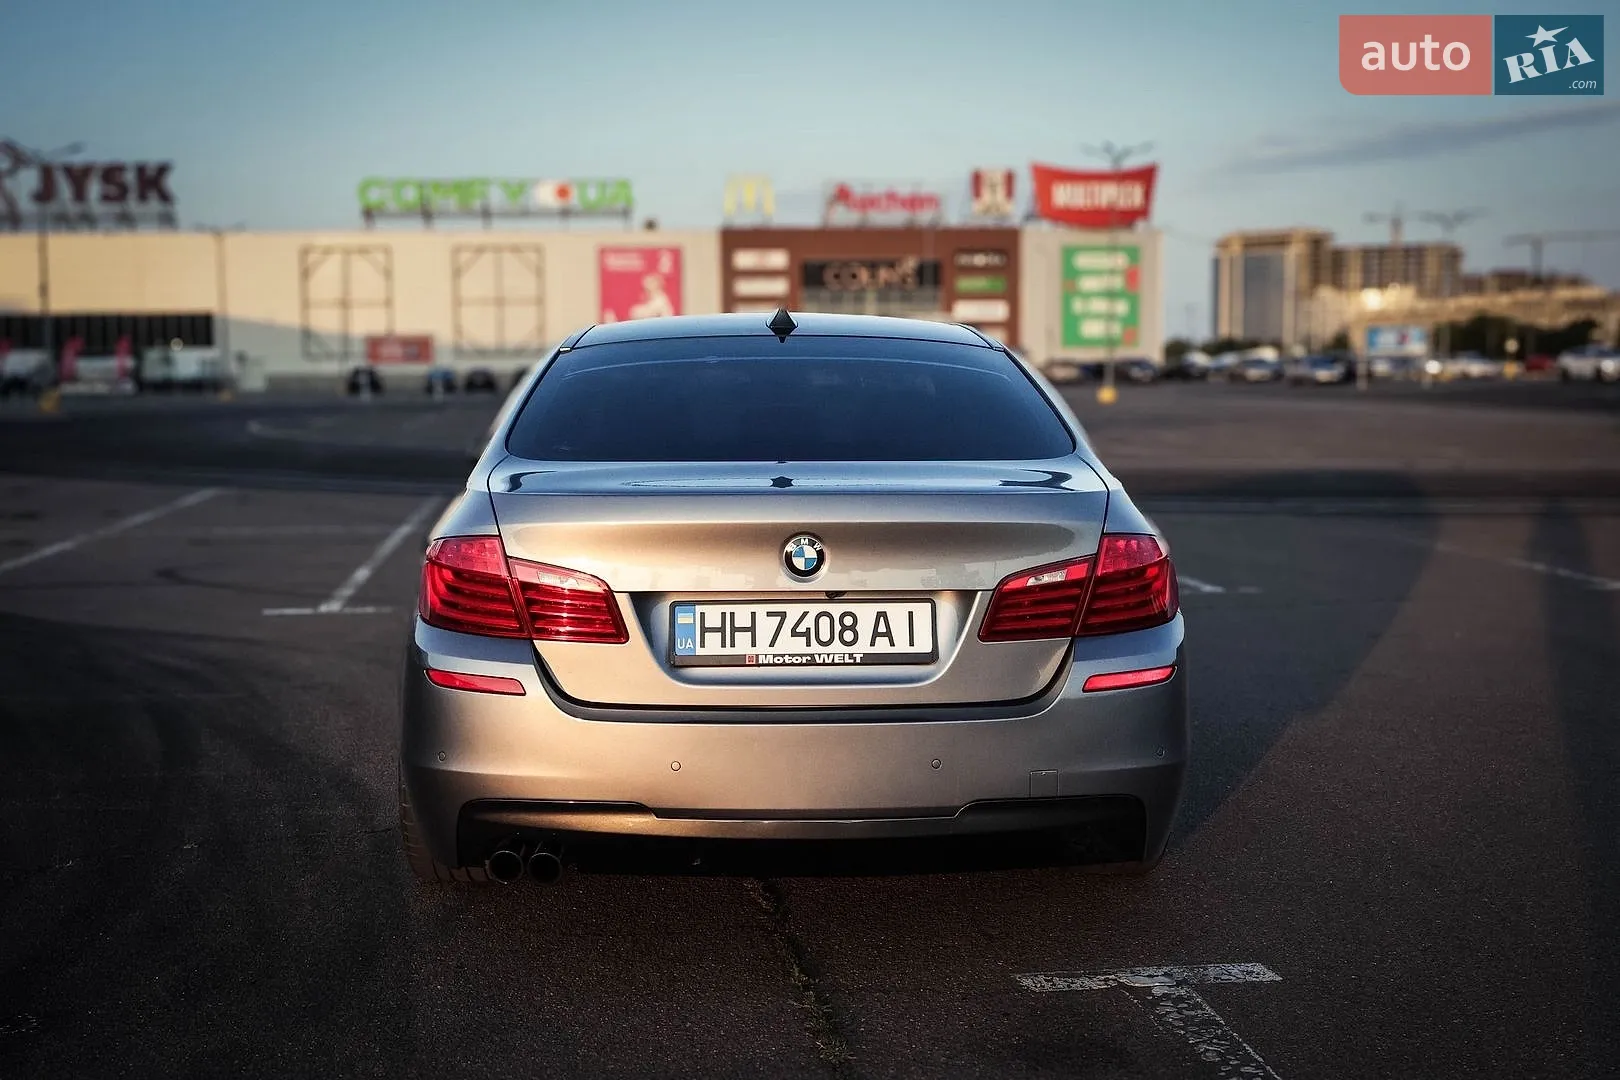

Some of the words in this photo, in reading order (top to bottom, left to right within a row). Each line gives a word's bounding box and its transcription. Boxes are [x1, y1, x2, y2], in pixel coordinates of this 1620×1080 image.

[31, 161, 173, 203] JYSK
[766, 610, 859, 647] 7408
[677, 638, 694, 649] UA
[758, 655, 811, 664] Motor
[814, 653, 864, 664] WELT
